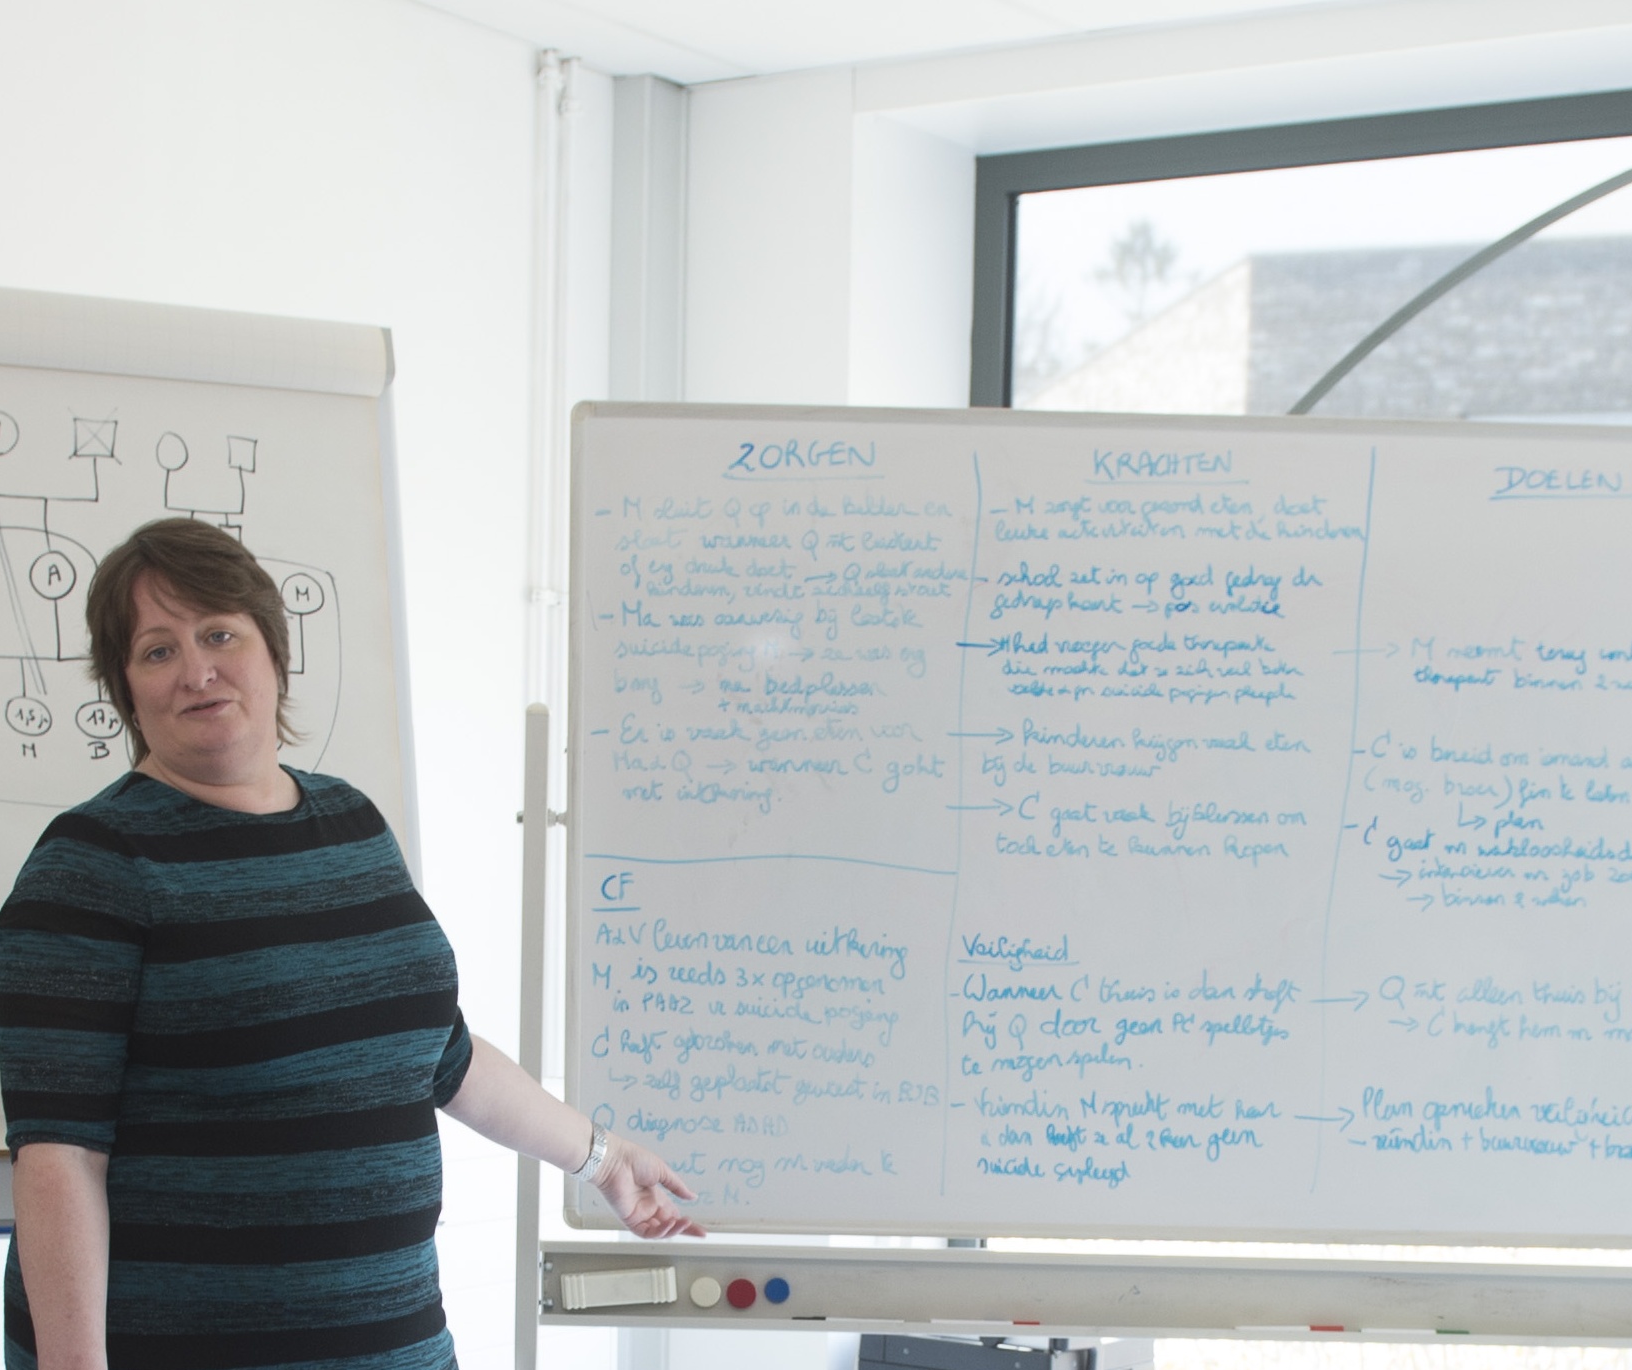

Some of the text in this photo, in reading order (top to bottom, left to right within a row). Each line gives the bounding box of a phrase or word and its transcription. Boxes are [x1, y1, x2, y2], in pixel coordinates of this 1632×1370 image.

[1094, 449, 1232, 480] KRACHTEN
[1494, 466, 1622, 495] DOELEN
[623, 496, 641, 518] M
[801, 529, 818, 560] Q
[47, 564, 63, 586] A
[620, 555, 640, 588] of
[295, 584, 311, 602] M
[22, 743, 37, 758] M
[87, 741, 110, 760] B
[1018, 791, 1040, 820] C
[600, 872, 635, 901] CF
[631, 958, 658, 984] is
[668, 961, 727, 986] reeds
[1379, 975, 1406, 1011] Q
[1008, 1012, 1027, 1051] Q
[1040, 1007, 1102, 1039] door
[1362, 1086, 1413, 1122] Plan
[733, 1112, 789, 1137] ADHD
